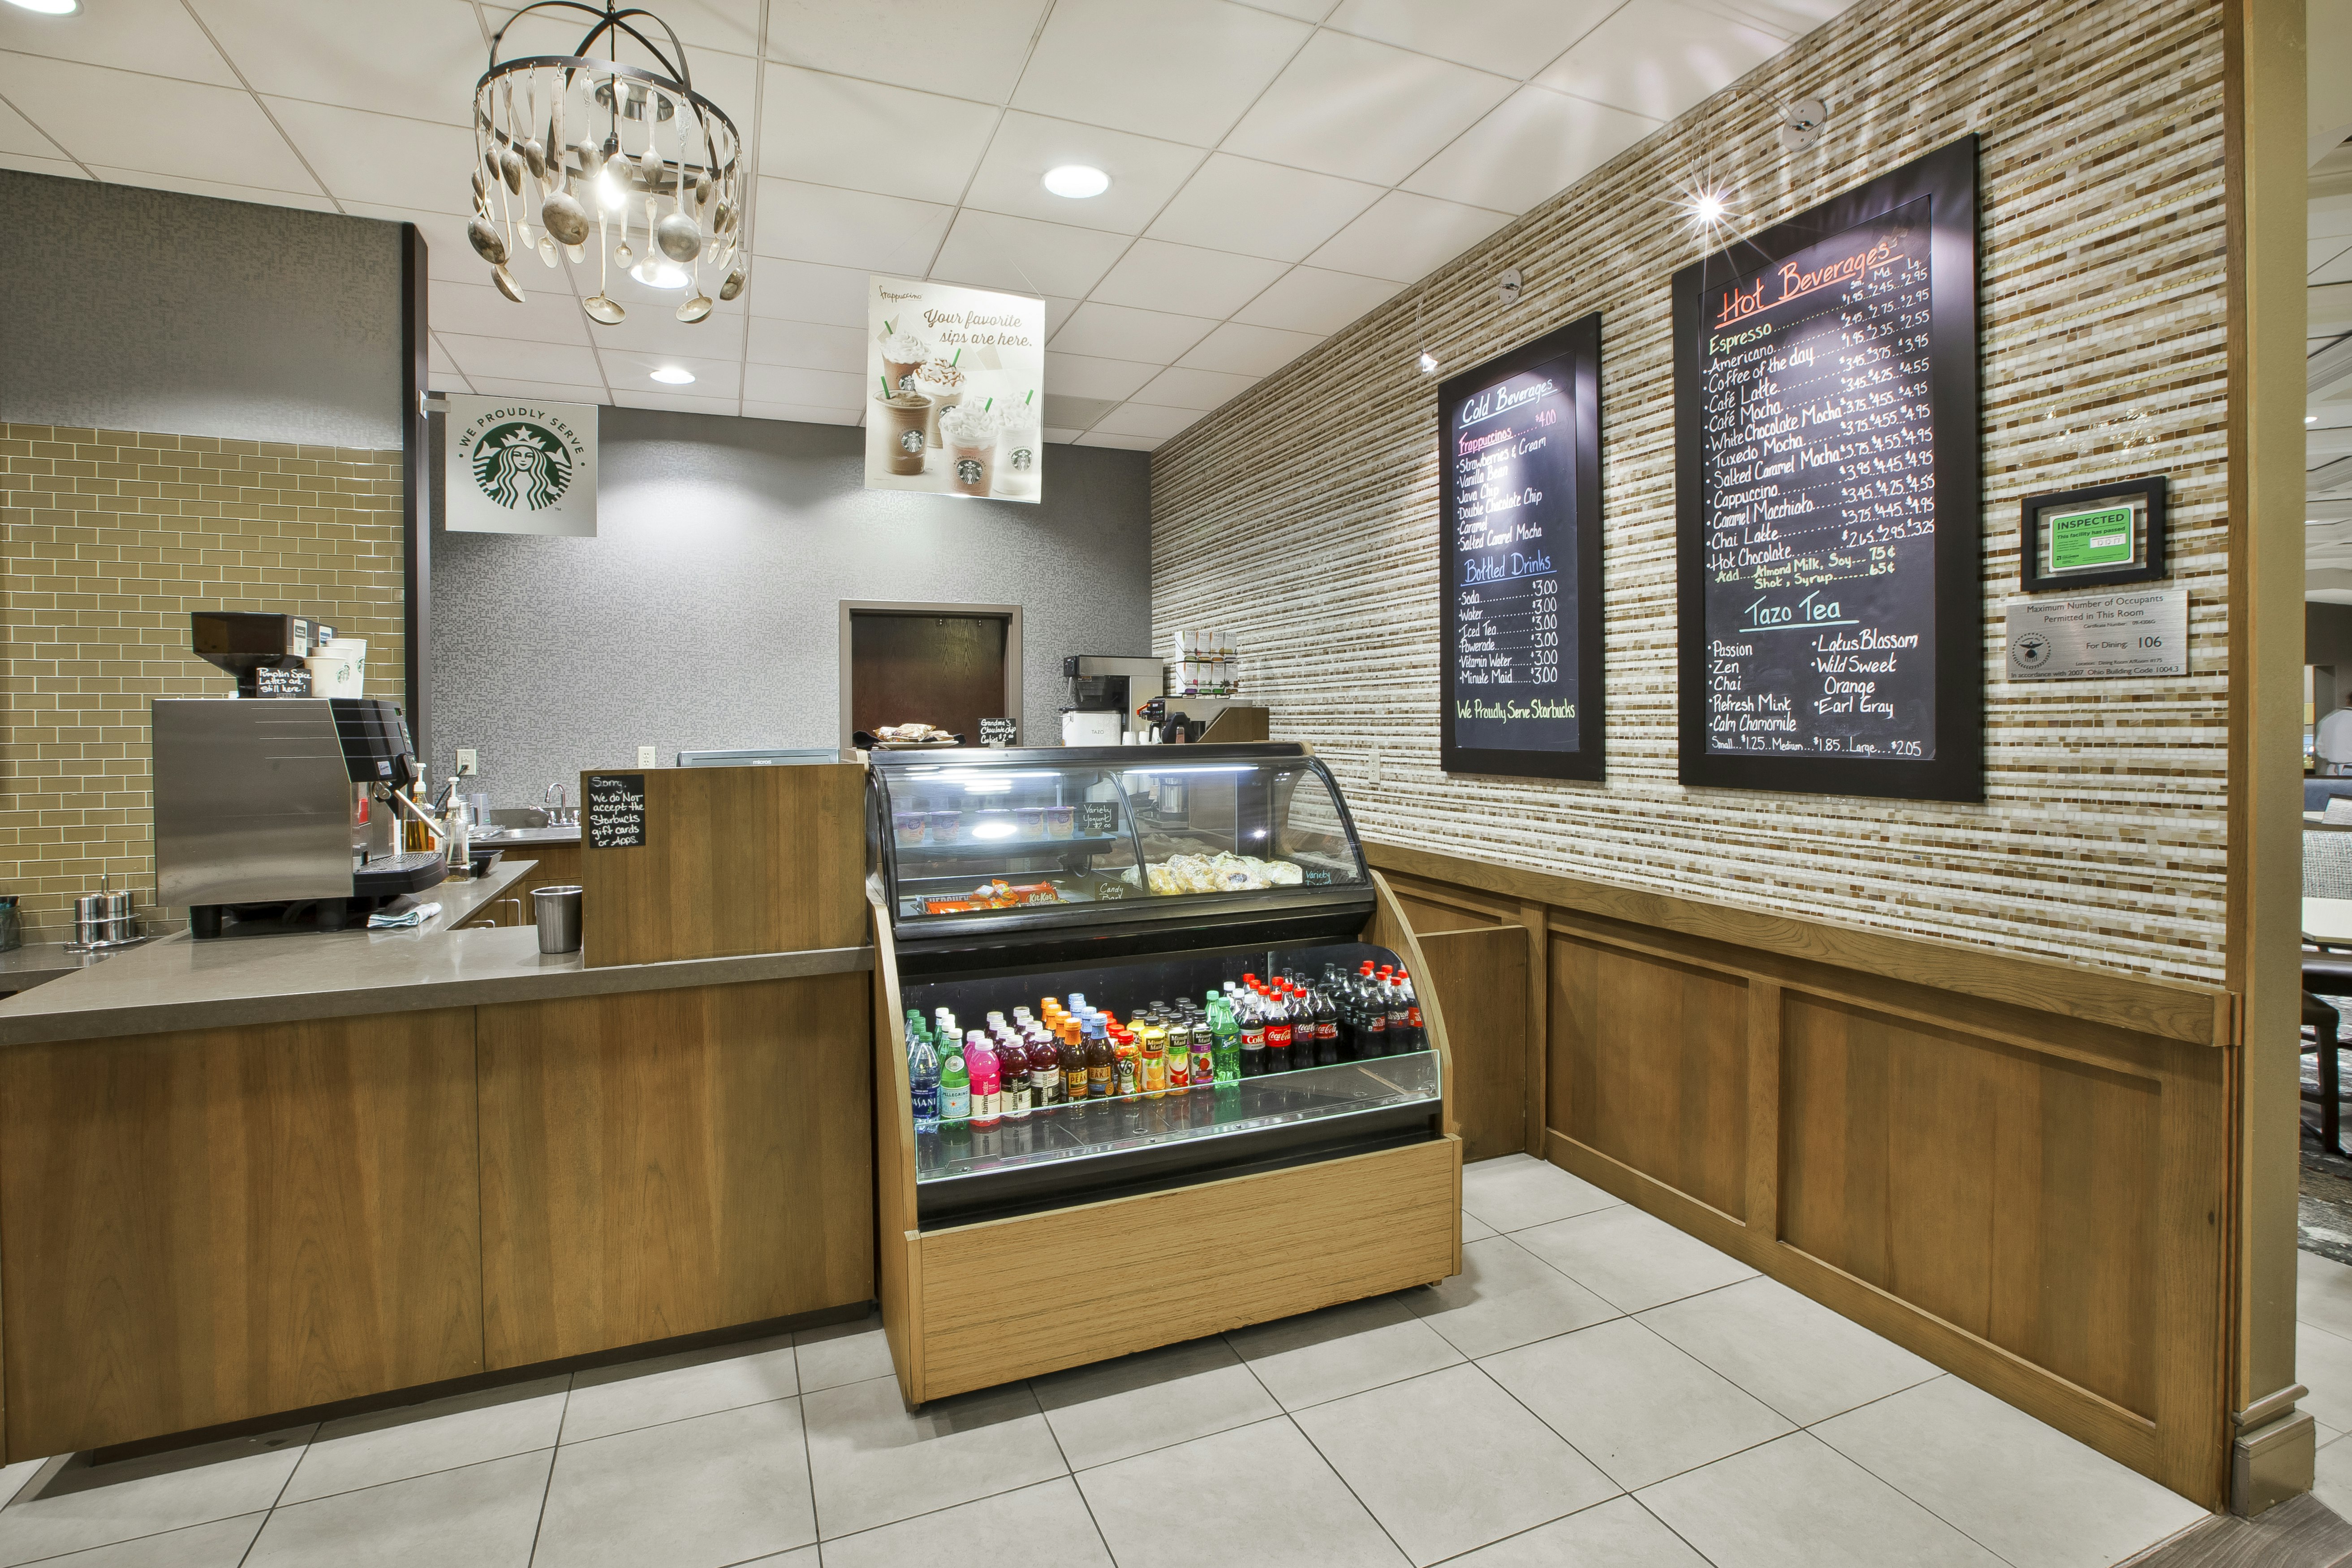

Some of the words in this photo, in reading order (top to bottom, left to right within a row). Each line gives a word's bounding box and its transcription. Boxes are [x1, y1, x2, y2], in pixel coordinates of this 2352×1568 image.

[1717, 278, 1765, 321] Hot
[1778, 242, 1890, 300] Beverages
[924, 309, 963, 328] Your
[965, 310, 1022, 329] favorite
[939, 330, 968, 345] sips
[971, 333, 995, 345] are
[997, 332, 1032, 346] here.
[1709, 323, 1772, 355] Espresso
[1707, 344, 1774, 375] Americano
[1709, 368, 1750, 393] Coffee
[1752, 360, 1767, 379] of
[1767, 356, 1787, 373] the
[1789, 347, 1815, 367] day
[1462, 393, 1490, 423] Cold
[1495, 379, 1553, 411] Beverages
[1709, 391, 1736, 413] Café
[1741, 377, 1778, 405] Latte
[459, 428, 477, 447] WE
[476, 407, 546, 427] PROUDLY
[550, 418, 584, 454] SERVE
[1710, 428, 1744, 451] White
[1745, 413, 1800, 442] Chocolate
[1801, 401, 1842, 427] Mocha
[1459, 427, 1512, 454] Frappuccinos
[1460, 448, 1509, 473] Strawberries
[1519, 436, 1546, 455] Cream
[1712, 445, 1758, 468] Tuxedo
[1763, 433, 1804, 456] Mocha
[1459, 468, 1484, 488] Vanilla
[1487, 465, 1508, 482] Bean
[1459, 489, 1478, 504] Java
[1480, 483, 1499, 500] Chip
[1714, 484, 1778, 510] Cappuccino
[1459, 502, 1483, 520] Double
[1486, 491, 1521, 514] Chocolate
[1524, 487, 1542, 506] Chip
[1713, 505, 1750, 530] Caramel
[1753, 493, 1814, 523] Macchiato
[2057, 513, 2124, 530] INSPECTED
[2103, 526, 2125, 534] passed
[1464, 554, 1505, 582] Bottled
[1510, 549, 1551, 576] Drinks
[1710, 551, 1736, 571] Hot
[1738, 542, 1792, 567] Chocolate
[1461, 590, 1480, 605] Soda
[2027, 605, 2064, 613] Maximum
[2067, 600, 2101, 610] Number
[2104, 598, 2115, 606] of
[2116, 595, 2163, 606] Occupants
[1460, 606, 1483, 622] Water
[1745, 595, 1792, 626] Tazo
[1798, 590, 1841, 621] Tea
[2043, 614, 2083, 623] Permitted
[2096, 611, 2114, 619] This
[2118, 609, 2144, 617] Room
[1460, 622, 1480, 639] Iced
[1482, 620, 1497, 636] Tea
[1460, 638, 1495, 653] Powerade
[1713, 640, 1753, 657] Passion
[1818, 632, 1859, 653] Lotus
[1859, 628, 1919, 650] Blossom
[2101, 641, 2128, 650] Dining
[2138, 636, 2162, 648] 106
[1460, 654, 1487, 668] Vitamin
[1489, 653, 1512, 667] Water
[1713, 660, 1740, 674] Zen
[1816, 655, 1848, 673] Wild
[1849, 652, 1897, 673] Sweet
[257, 667, 289, 678] Pumpkin
[291, 669, 312, 679] Spice
[258, 677, 287, 685] Lattes
[1462, 669, 1489, 684] Minute
[1491, 668, 1513, 684] Maid
[2106, 668, 2132, 676] Building
[1824, 676, 1876, 699] Orange
[1457, 700, 1473, 719] We
[1474, 699, 1507, 724] Proudly
[1507, 699, 1530, 719] Serve
[1531, 698, 1575, 719] Starbucks
[1713, 694, 1754, 712] Refresh
[1758, 693, 1792, 712] Mint
[1818, 695, 1853, 715] Earl
[1859, 696, 1894, 719] Gray
[1713, 714, 1736, 732] Calm
[1739, 712, 1797, 732] Chamomile
[980, 735, 998, 744] Cookies
[1711, 736, 1733, 750] Small
[1772, 737, 1803, 751] Medium
[1850, 736, 1878, 757] Large
[590, 793, 608, 803] We
[609, 793, 620, 802] do
[593, 803, 627, 815] accept
[628, 801, 645, 811] the
[1083, 803, 1112, 822] Variety
[590, 814, 641, 825] Starbucks
[591, 825, 613, 840] gift
[615, 824, 640, 835] cards
[1305, 870, 1330, 883] Variety
[1100, 883, 1124, 897] Candy
[1223, 1037, 1236, 1048] Sprite
[1247, 1035, 1264, 1044] Coke
[1120, 1058, 1133, 1075] V8
[1070, 1075, 1087, 1083] PEAK
